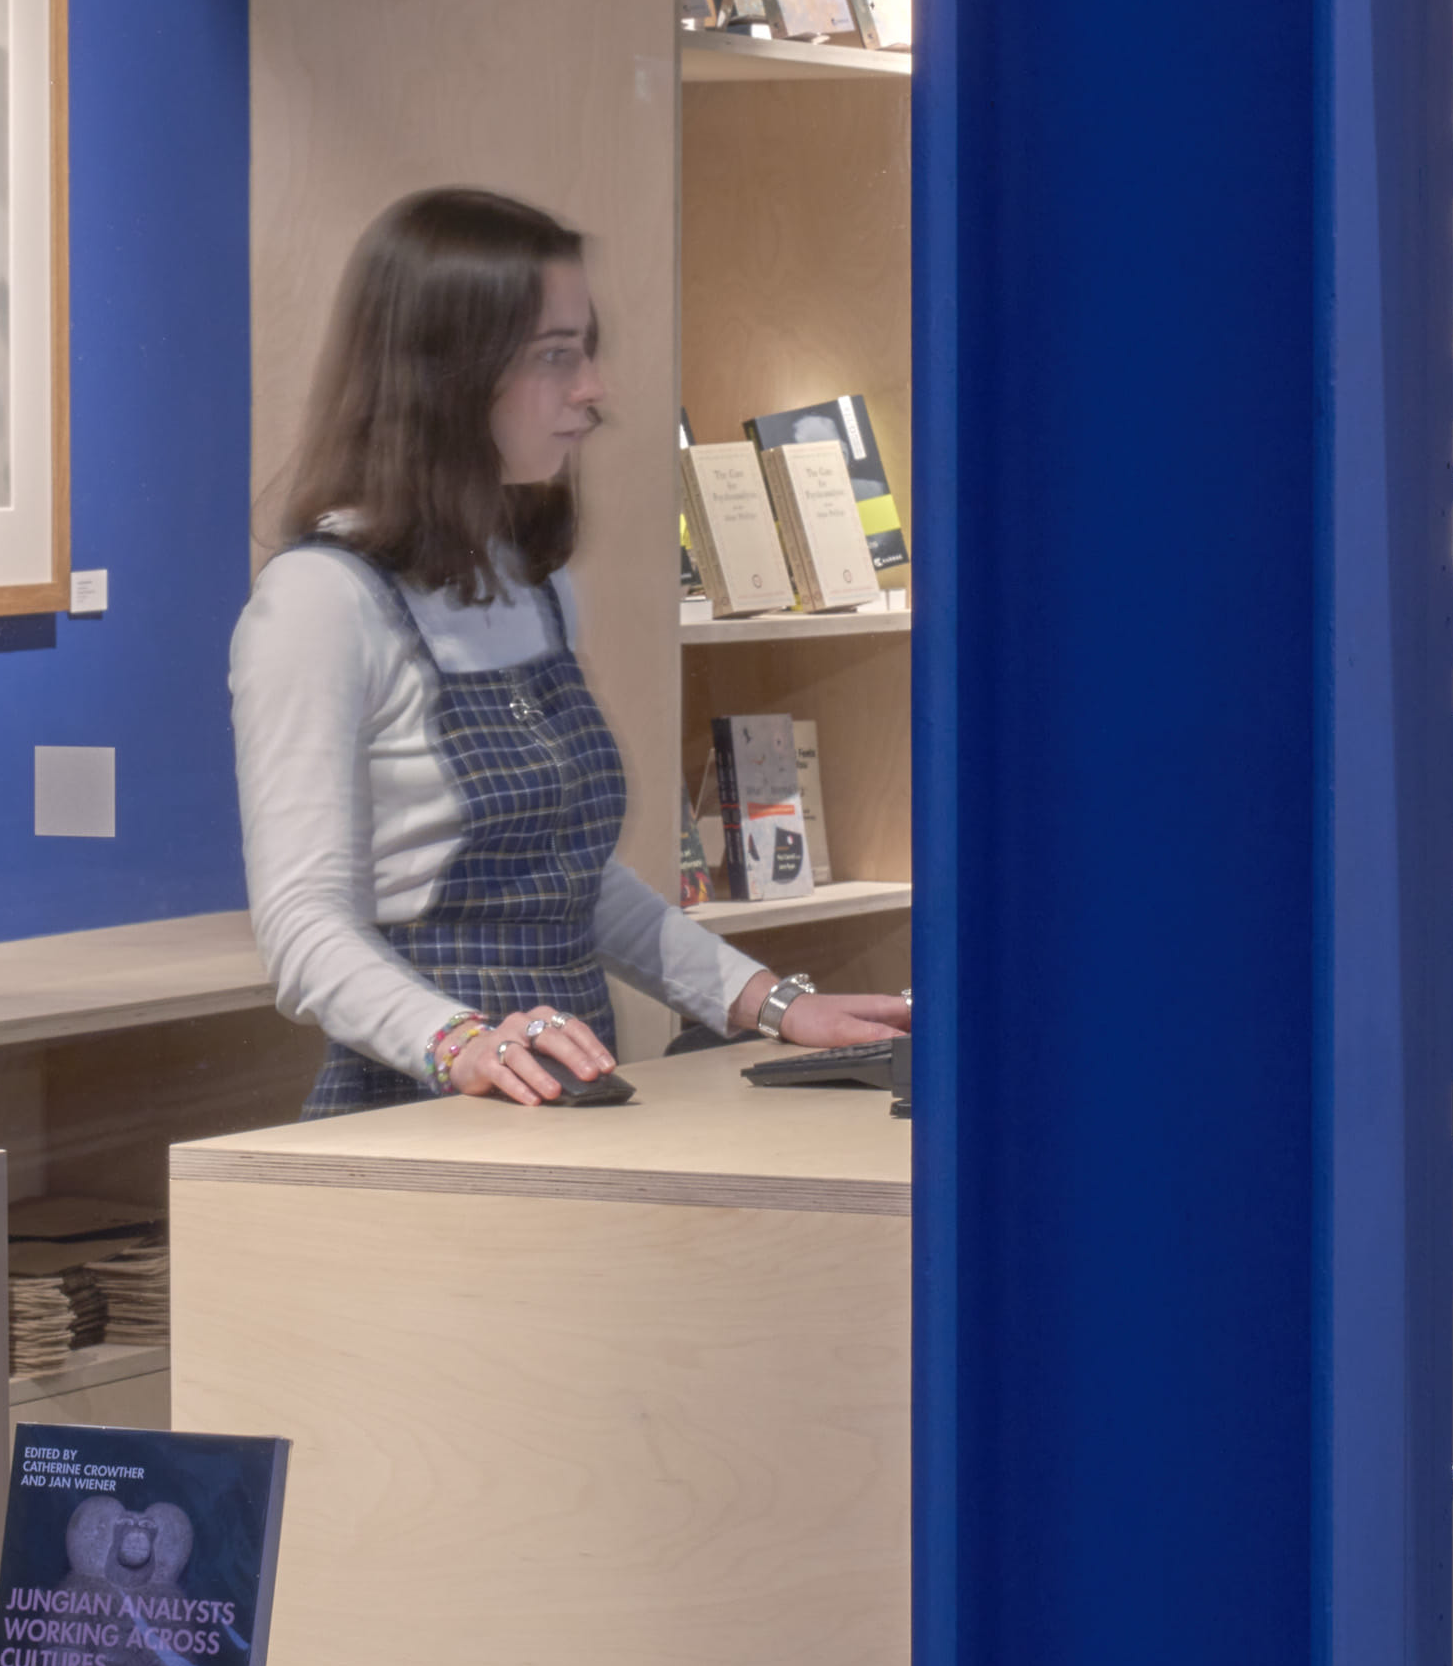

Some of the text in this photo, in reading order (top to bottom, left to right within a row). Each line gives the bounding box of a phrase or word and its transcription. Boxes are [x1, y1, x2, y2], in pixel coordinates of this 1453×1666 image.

[25, 1447, 77, 1461] EDITED BY
[23, 1461, 145, 1480] CATHERINE CROWTHER
[21, 1475, 116, 1492] AND JAN WIENER
[6, 1588, 235, 1625] JUNGIAN ANALYSTS
[4, 1618, 220, 1654] WORKING ACROSS
